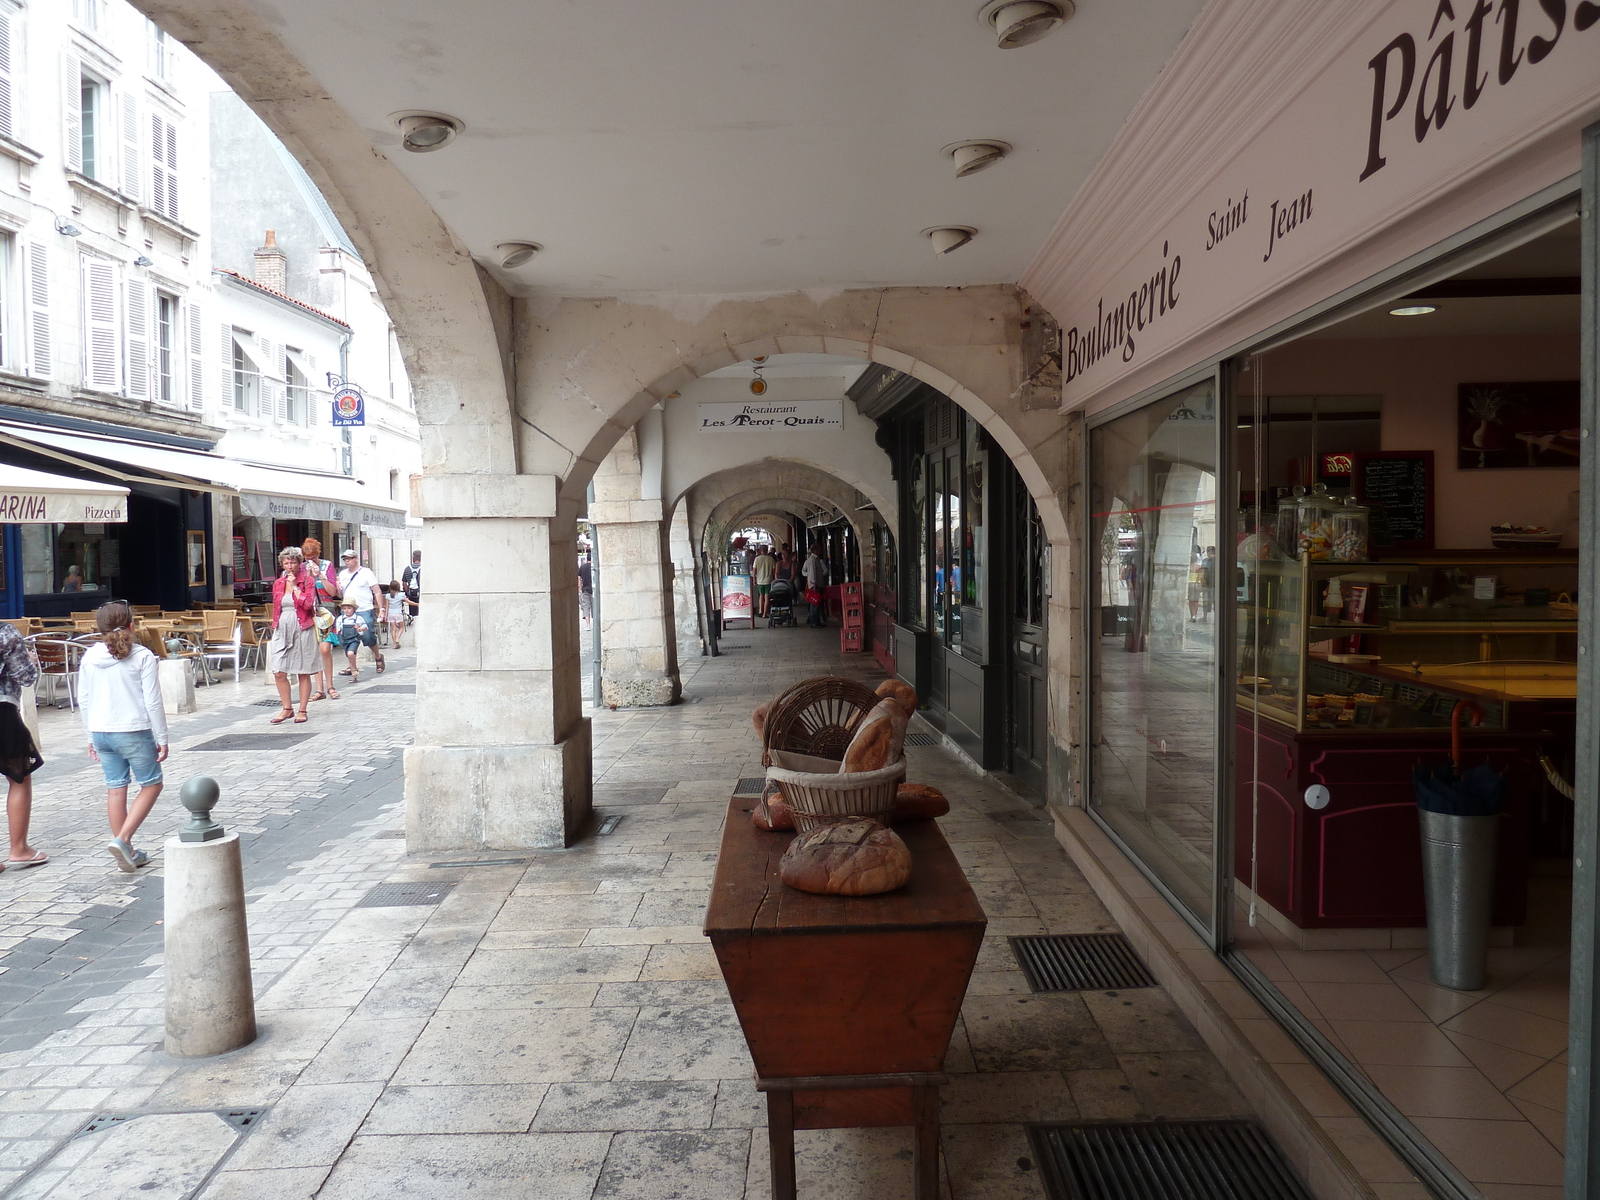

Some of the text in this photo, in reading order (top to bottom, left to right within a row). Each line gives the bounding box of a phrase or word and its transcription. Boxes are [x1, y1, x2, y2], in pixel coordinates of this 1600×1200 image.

[1359, 0, 1600, 183] Pâtis
[1206, 188, 1249, 251] Saint
[1263, 188, 1313, 263] Jean
[1065, 239, 1181, 385] Boulangerie
[702, 418, 726, 428] Les
[742, 405, 798, 415] Restaurant
